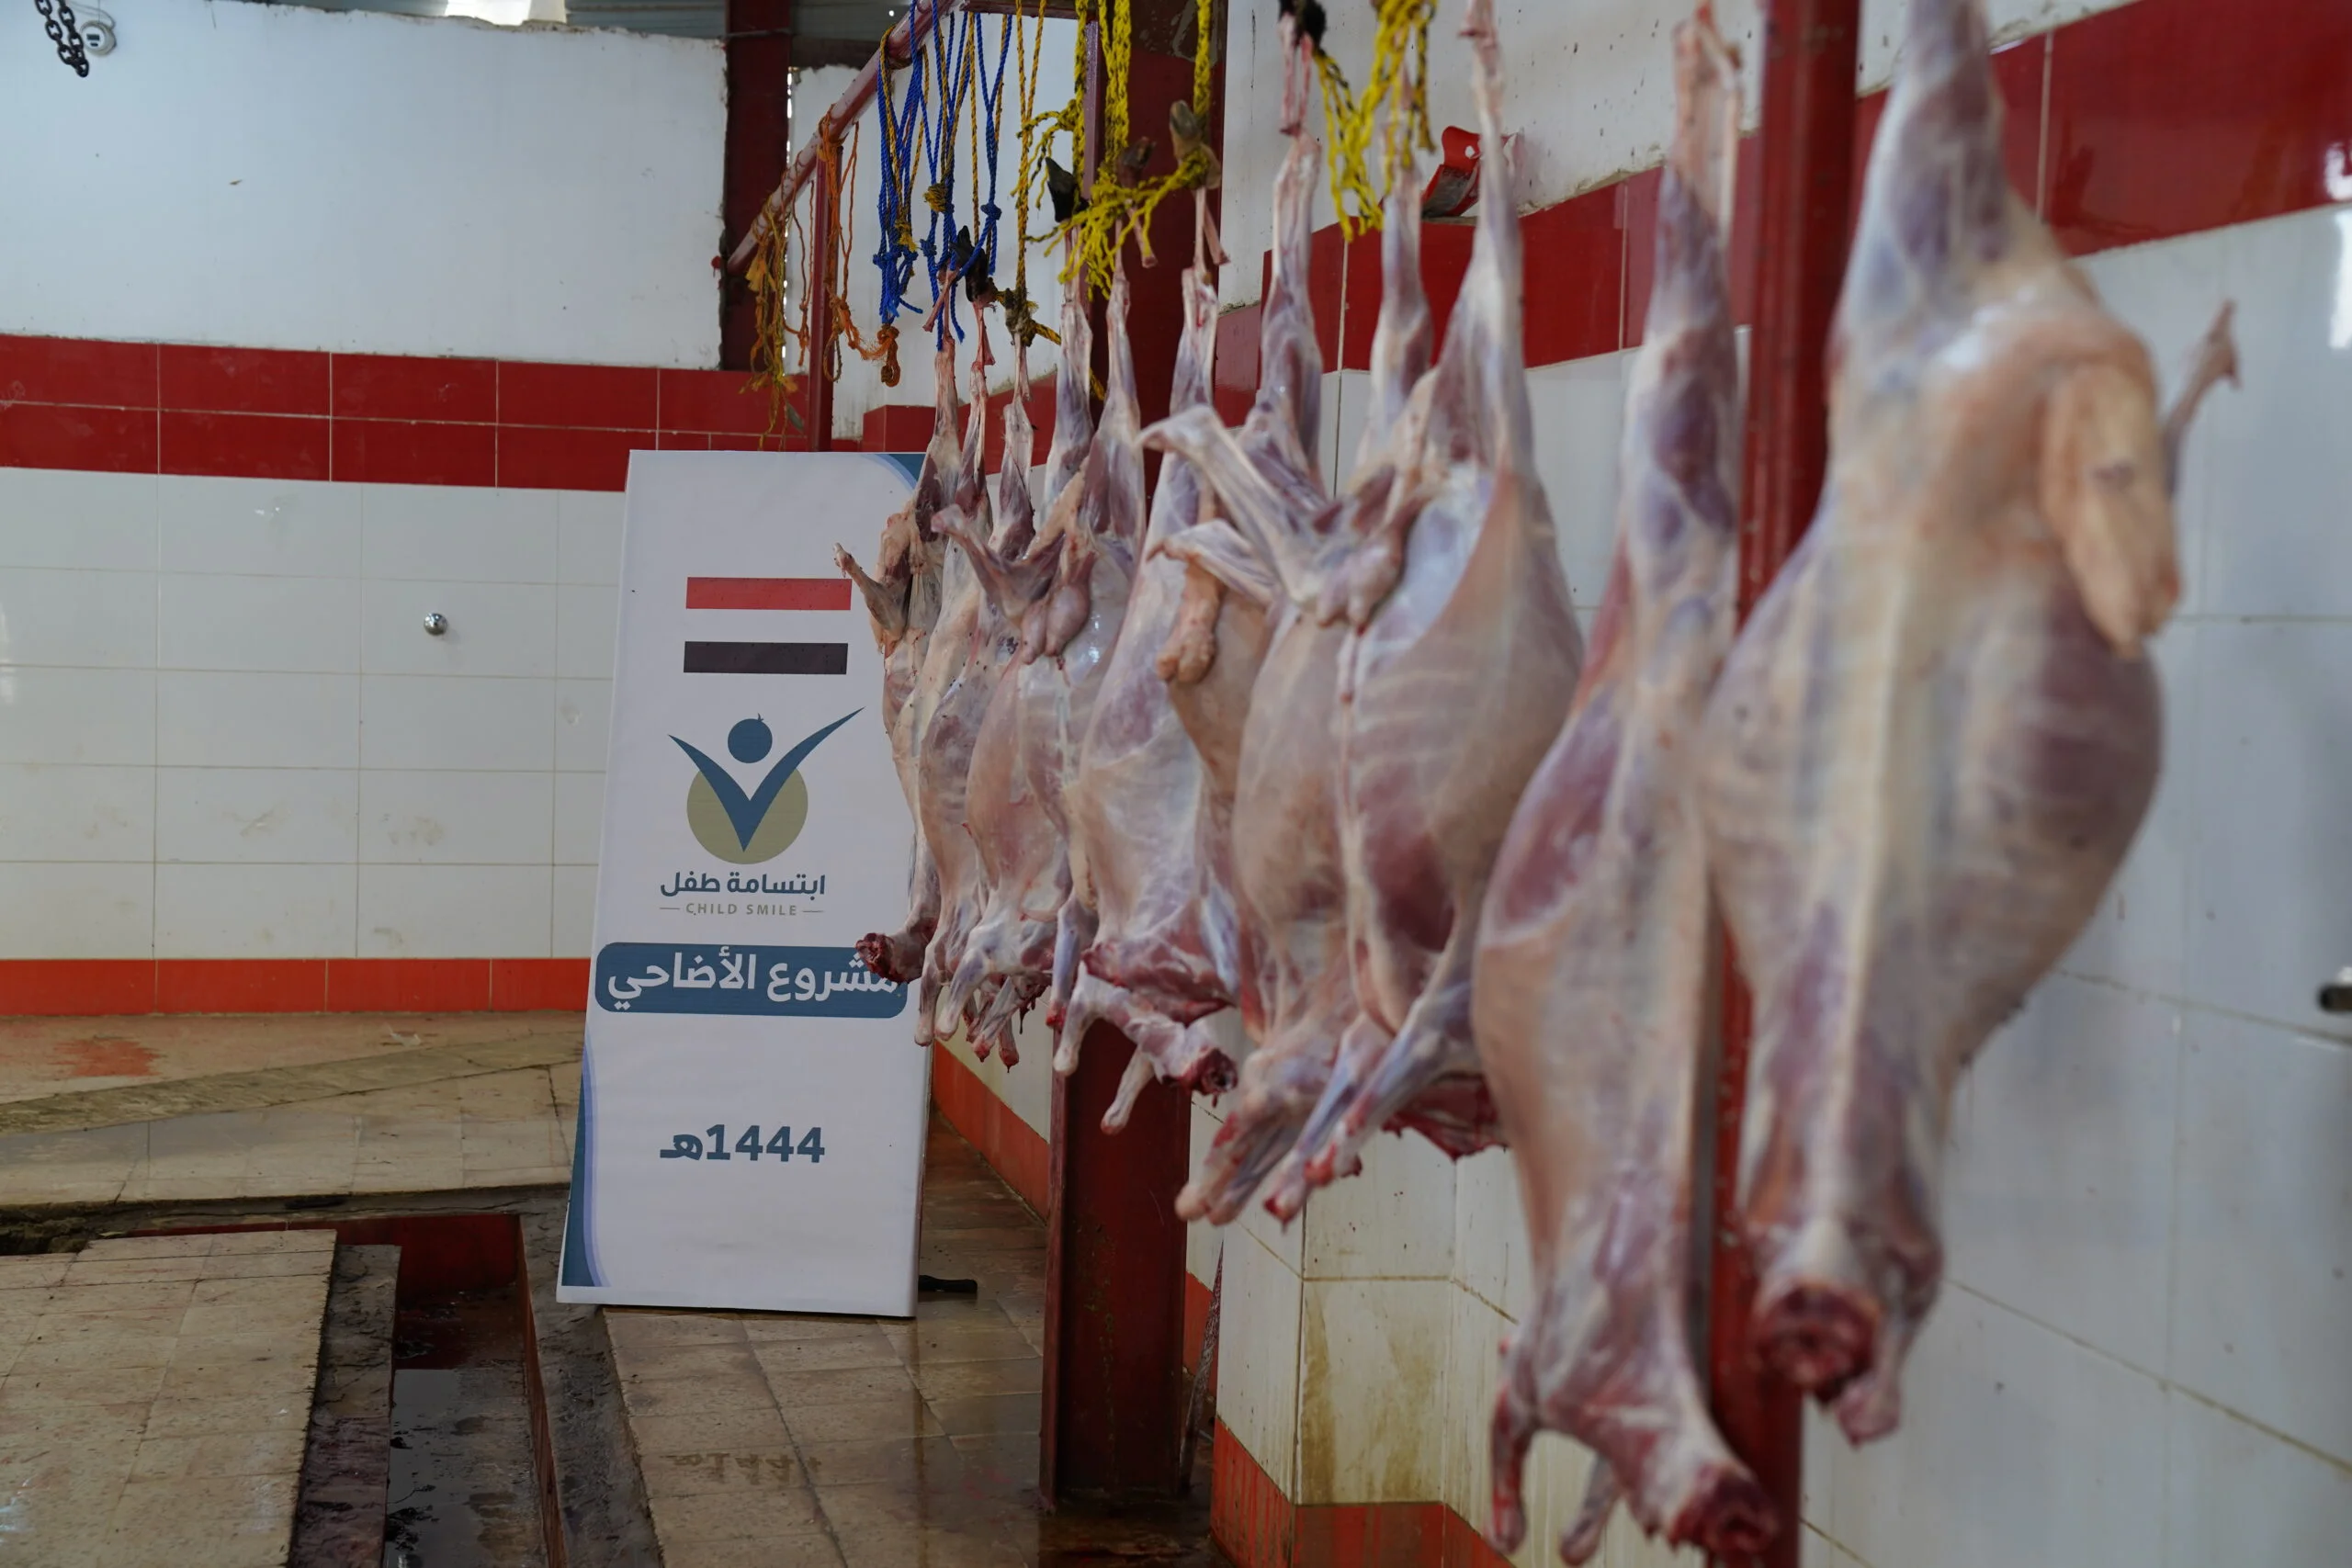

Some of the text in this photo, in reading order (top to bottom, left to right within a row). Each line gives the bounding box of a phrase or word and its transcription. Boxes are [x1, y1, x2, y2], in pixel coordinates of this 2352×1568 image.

[661, 871, 825, 900] ابتسامة طفل
[685, 903, 797, 916] CHILD SMILE
[607, 945, 757, 1010] الأضاحي
